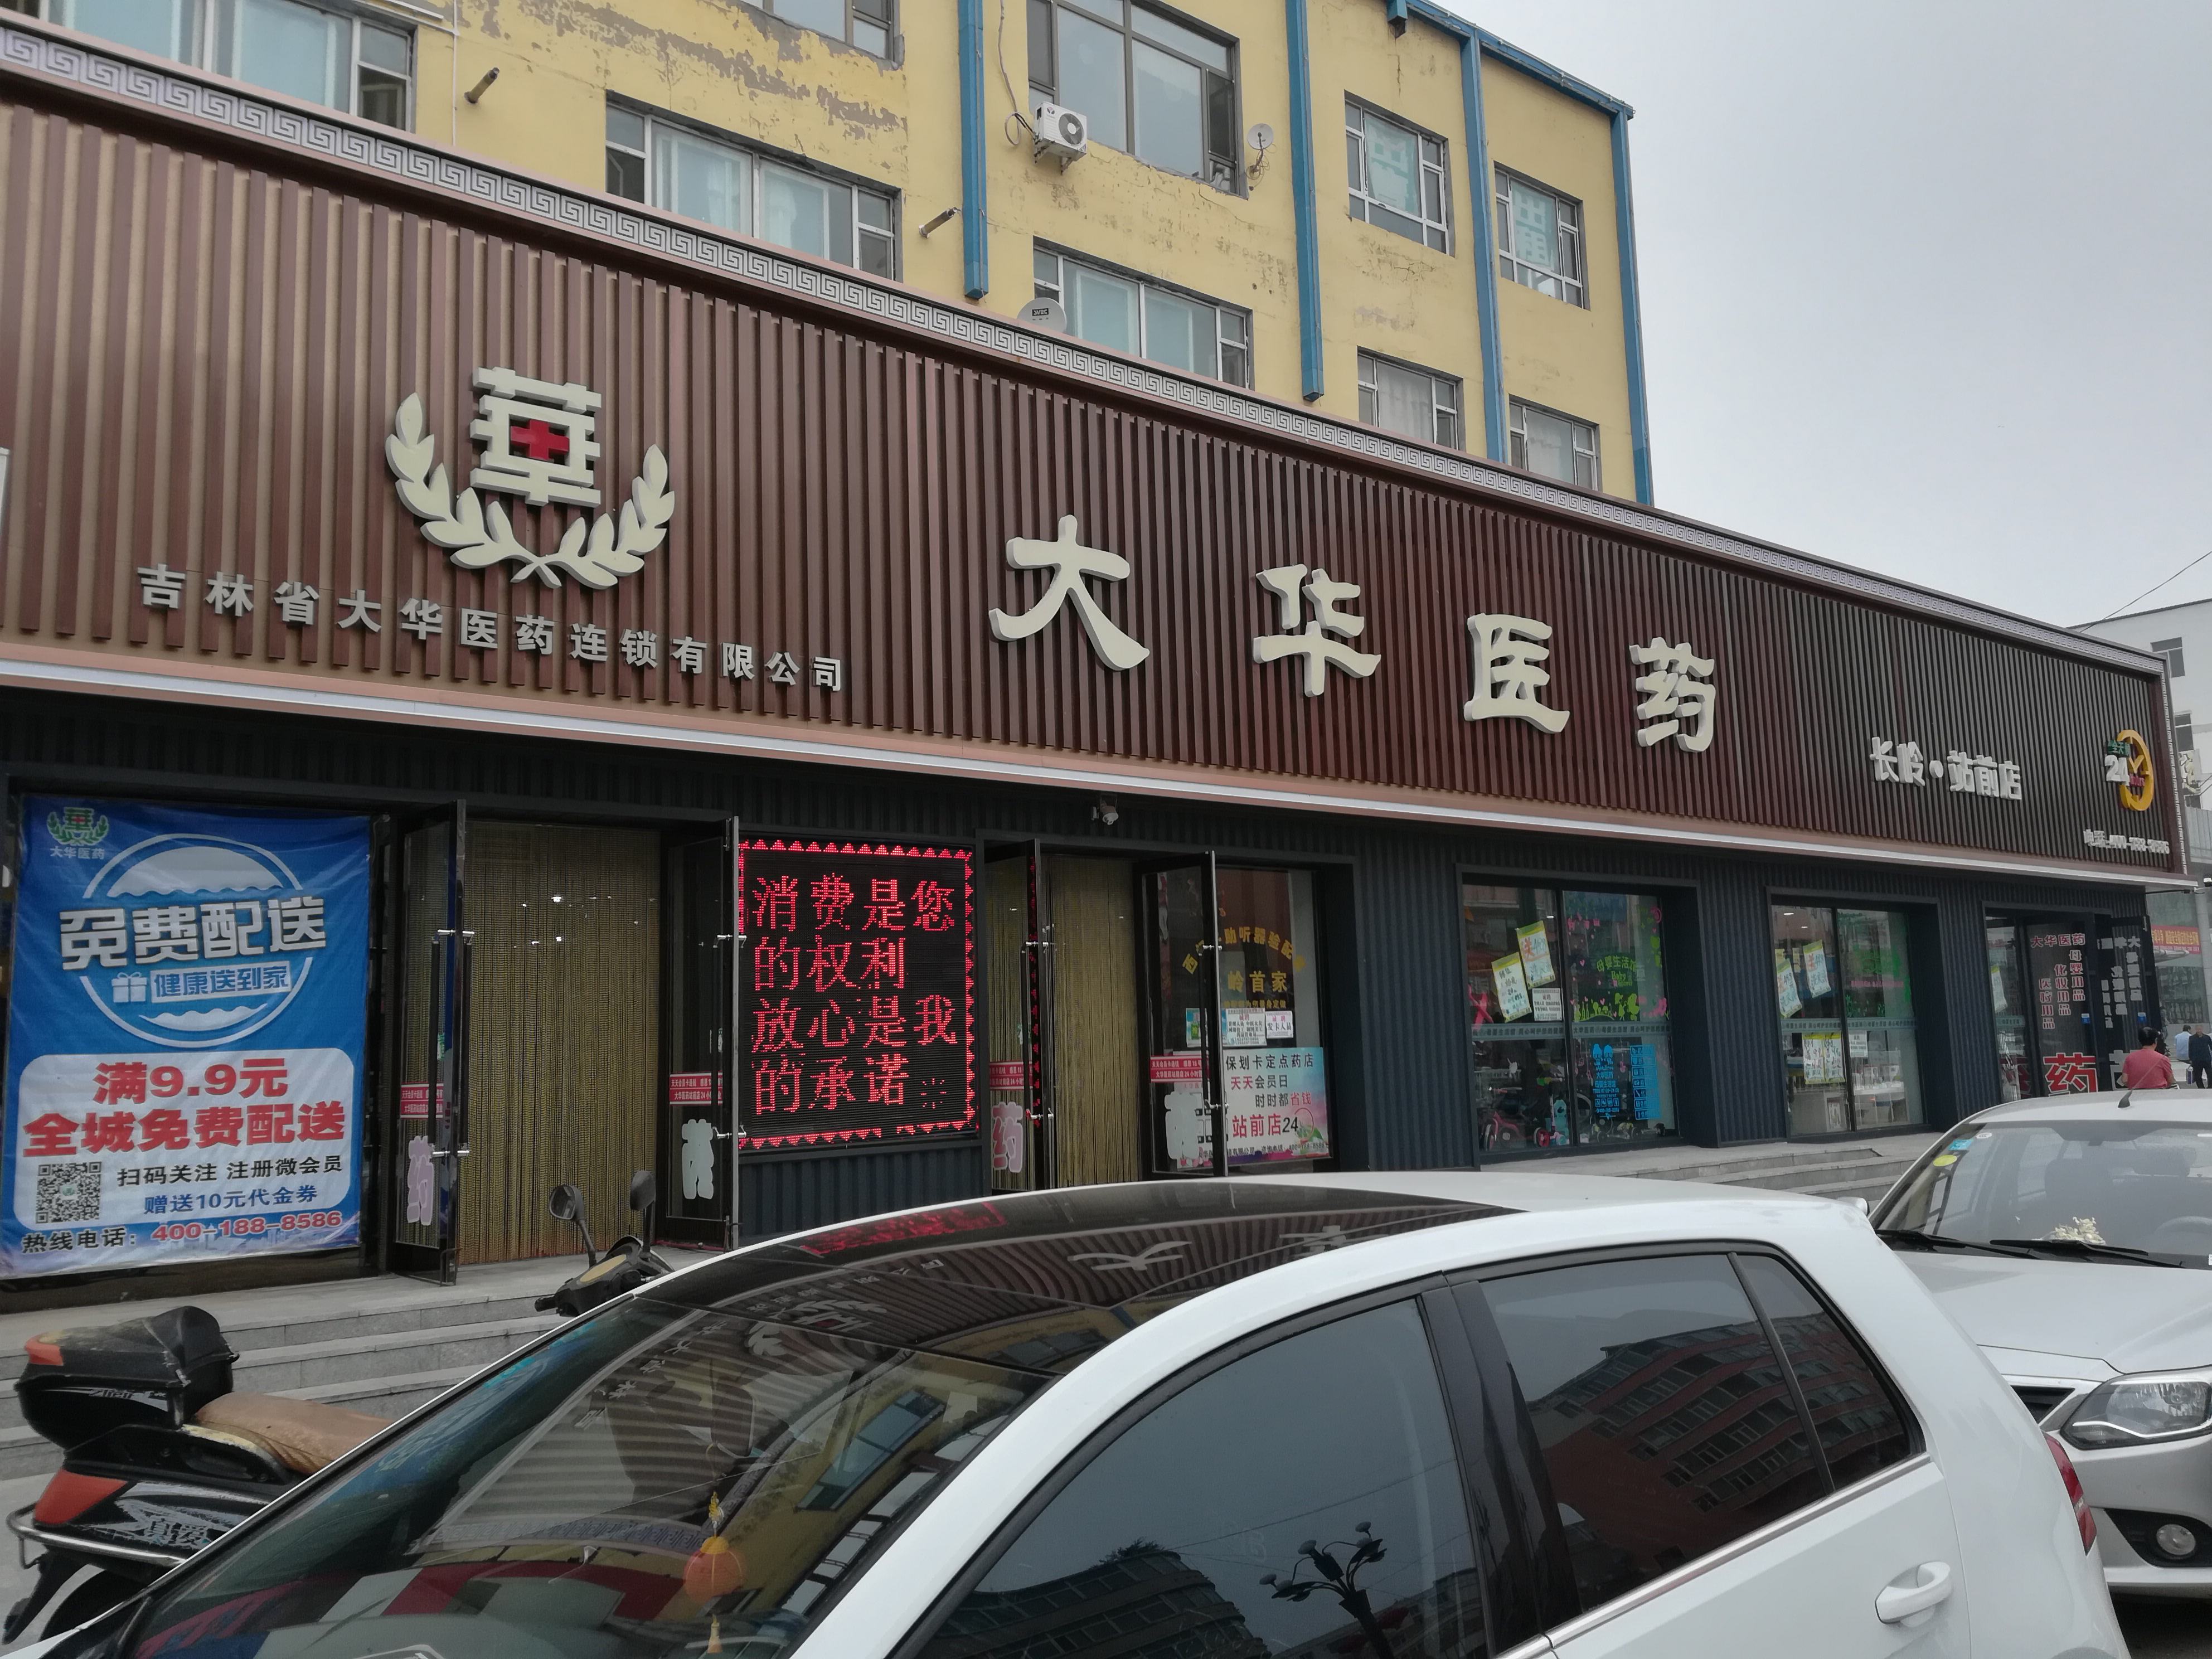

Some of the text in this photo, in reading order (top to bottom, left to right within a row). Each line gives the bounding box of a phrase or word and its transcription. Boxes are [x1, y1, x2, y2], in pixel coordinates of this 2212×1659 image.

[138, 563, 843, 692] 吉林省大华医药连锁有限公司
[989, 514, 1718, 753] 大华医药
[2104, 754, 2130, 787] 24
[50, 845, 105, 860] 大华医药
[751, 872, 955, 932] 消费是您
[59, 895, 327, 970] 免费配送
[2030, 933, 2085, 948] 大华医药
[154, 963, 290, 999] 健康送到家
[755, 934, 906, 992] 的权利
[1611, 971, 1626, 981] Baby
[2069, 949, 2085, 1002] 母婴用品
[2039, 978, 2055, 1030] 医疗用品
[2054, 964, 2072, 1016] 化妆用品
[751, 995, 958, 1053] 放心是我
[1267, 1022, 1292, 1031] 发卡人员
[93, 1058, 289, 1106] 满9.9元
[751, 1052, 910, 1115] 的承诺
[1226, 1053, 1314, 1071] 保划卡定点药店
[1230, 1074, 1288, 1091] 天天会员日
[2043, 1052, 2098, 1097] 药
[1255, 1092, 1312, 1108] 时时都省钱
[22, 1100, 346, 1158] 全城免费配送
[992, 1101, 1023, 1173] 药
[117, 1156, 343, 1186] 扫码关注 注册微会员
[407, 1135, 434, 1226] 药
[143, 1184, 318, 1215] 赠送10元代金券
[21, 1211, 342, 1254] 热线电话: 400-188-8586
